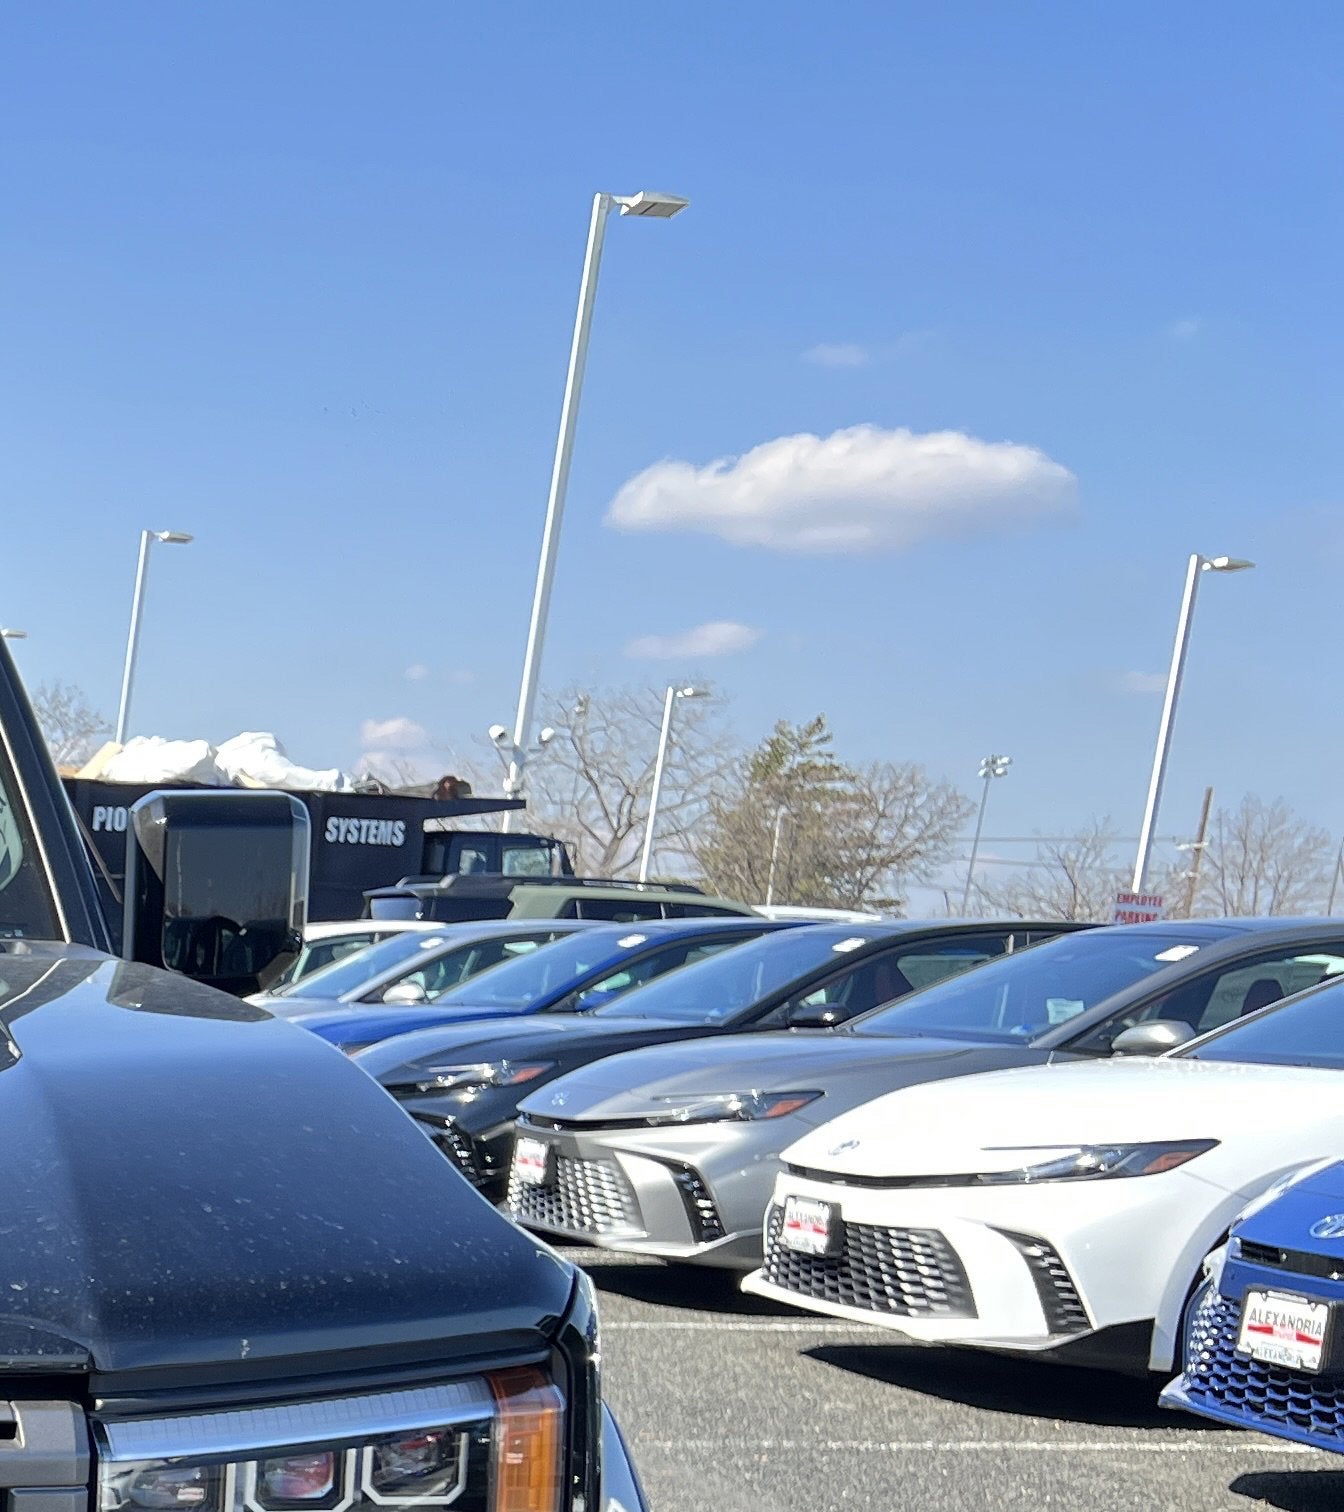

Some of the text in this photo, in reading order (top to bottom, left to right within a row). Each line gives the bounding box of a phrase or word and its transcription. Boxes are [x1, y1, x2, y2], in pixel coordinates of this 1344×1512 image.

[324, 816, 407, 848] SYSTEMS
[1116, 893, 1163, 907] EMPLOYEE
[1248, 1307, 1323, 1336] ALEXANDRIA
